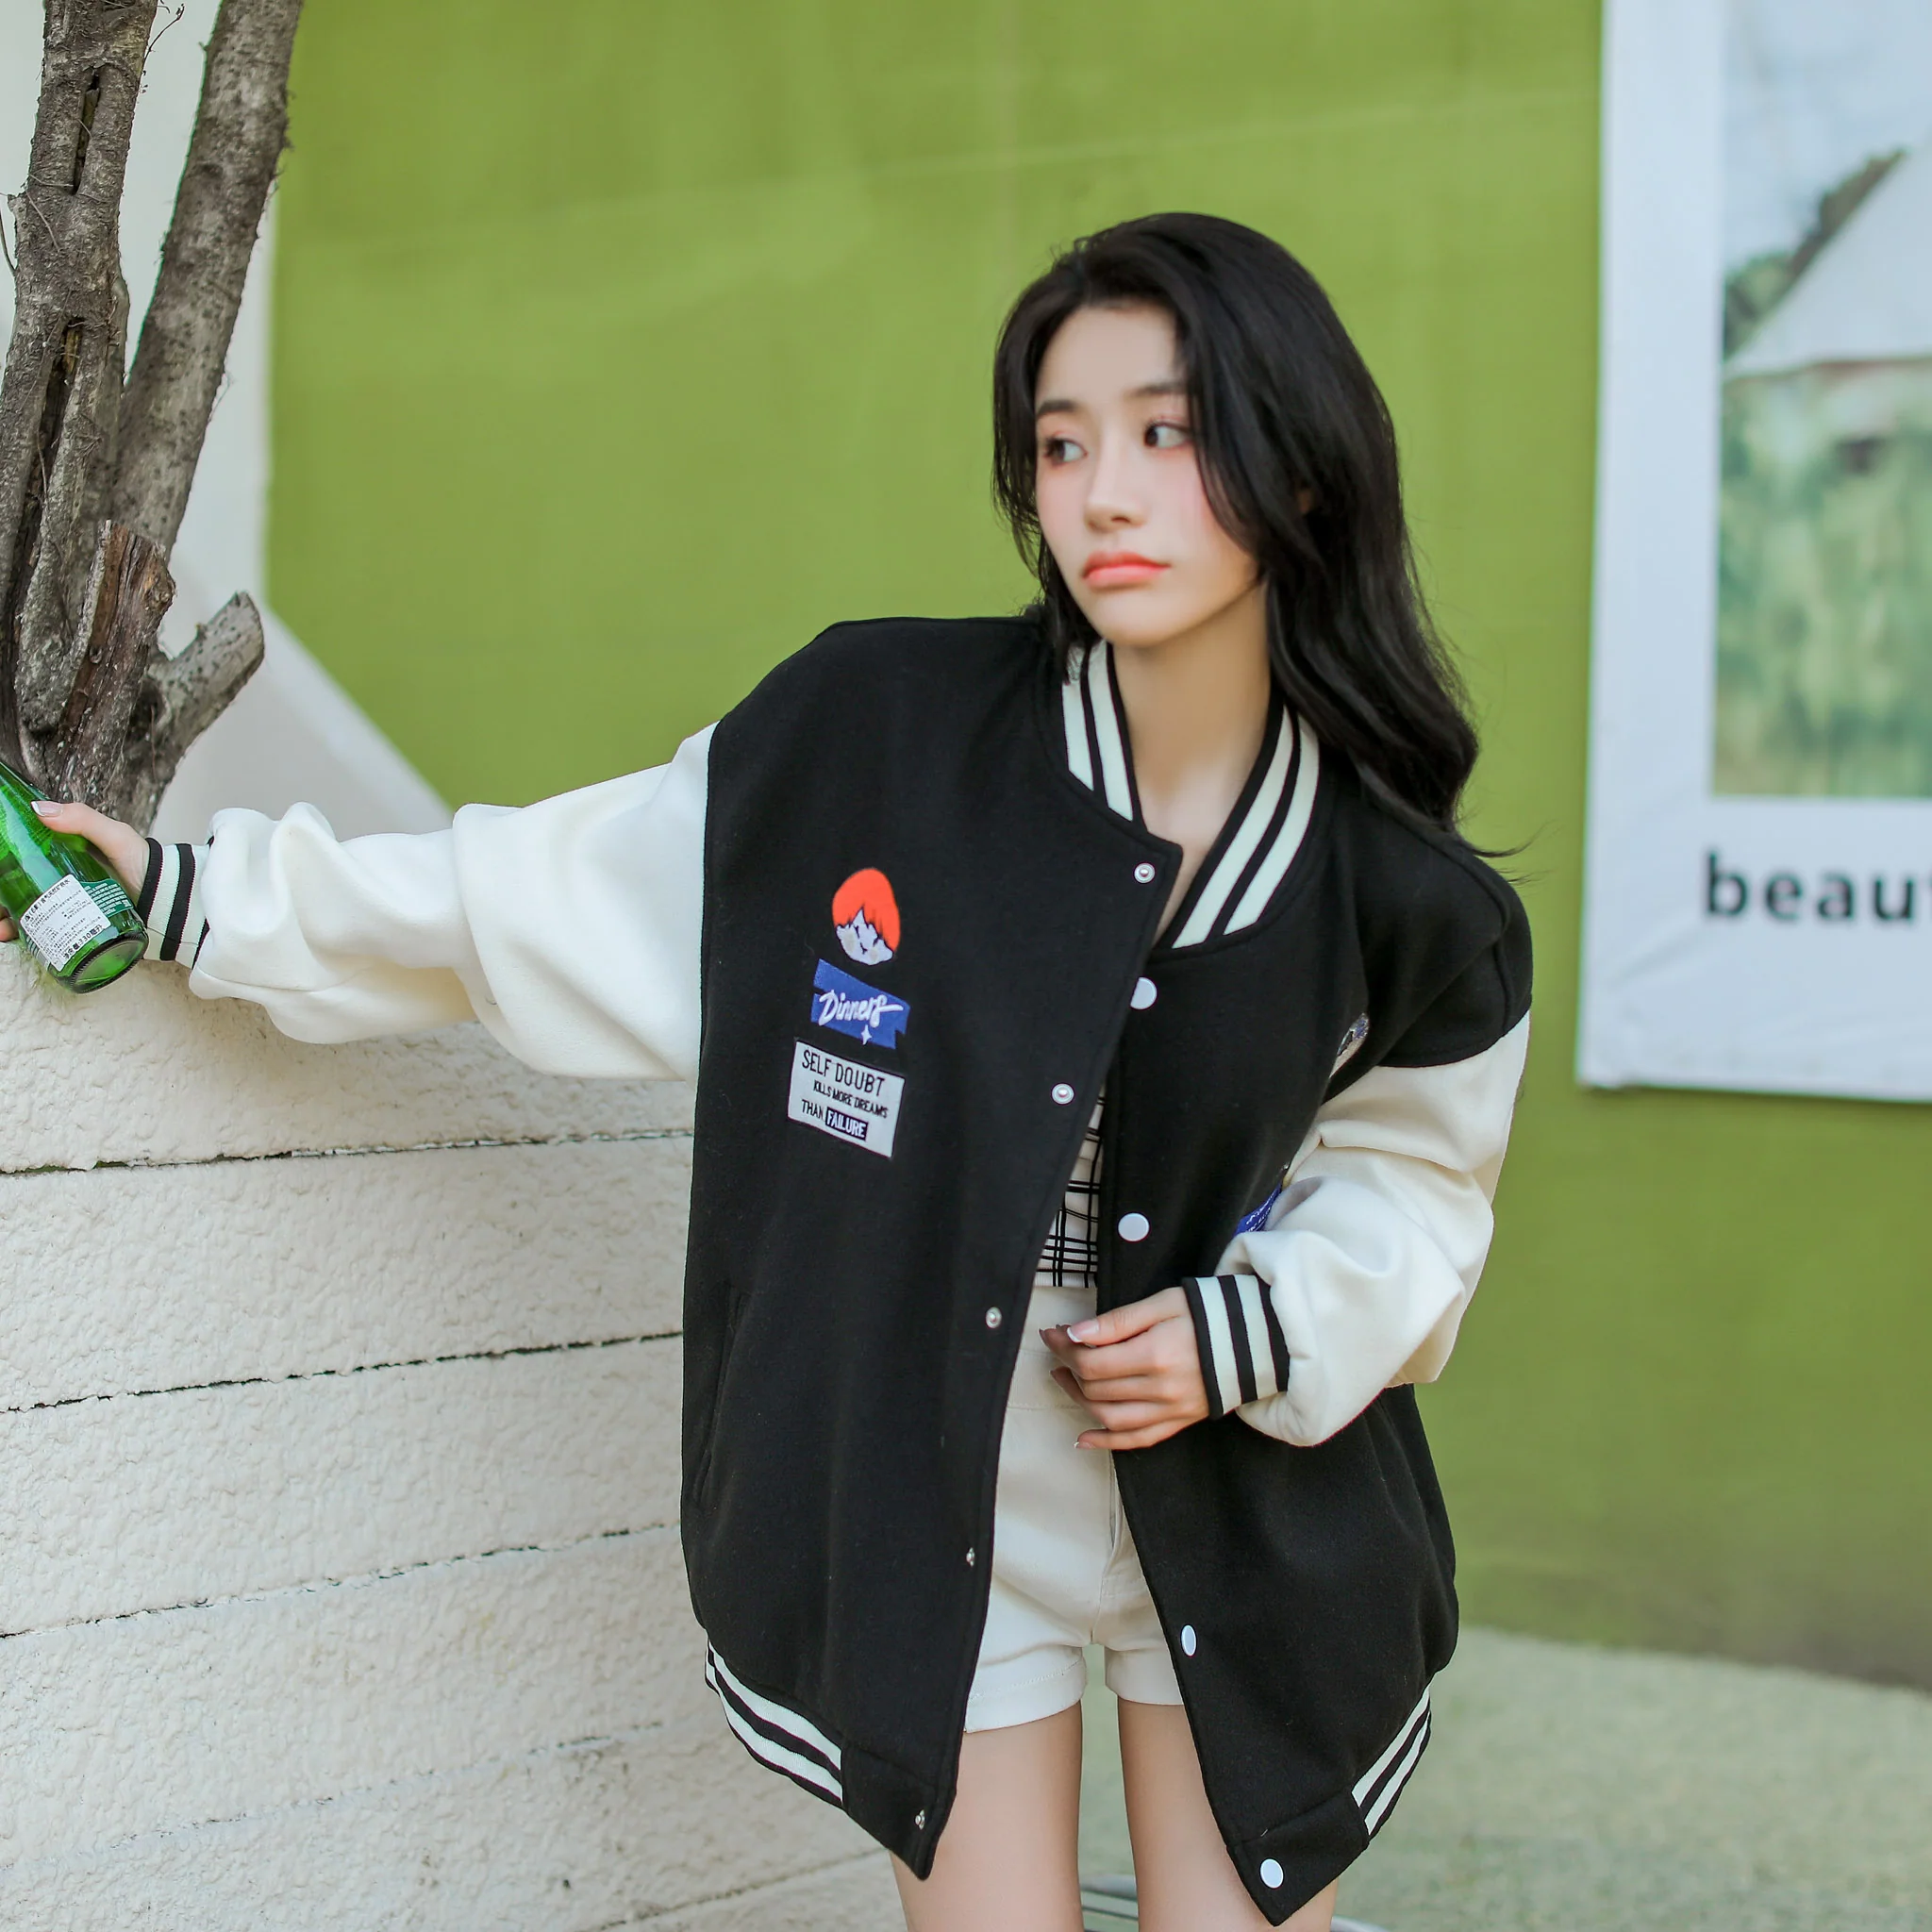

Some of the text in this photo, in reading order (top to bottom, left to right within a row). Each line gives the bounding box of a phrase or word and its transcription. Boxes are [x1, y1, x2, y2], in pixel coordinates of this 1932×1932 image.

[1705, 848, 1932, 923] beau
[802, 1049, 885, 1096] SELF DOUBT
[802, 1099, 866, 1138] THAN FAILURE
[813, 1080, 889, 1119] KILLS MORE DREAMS
